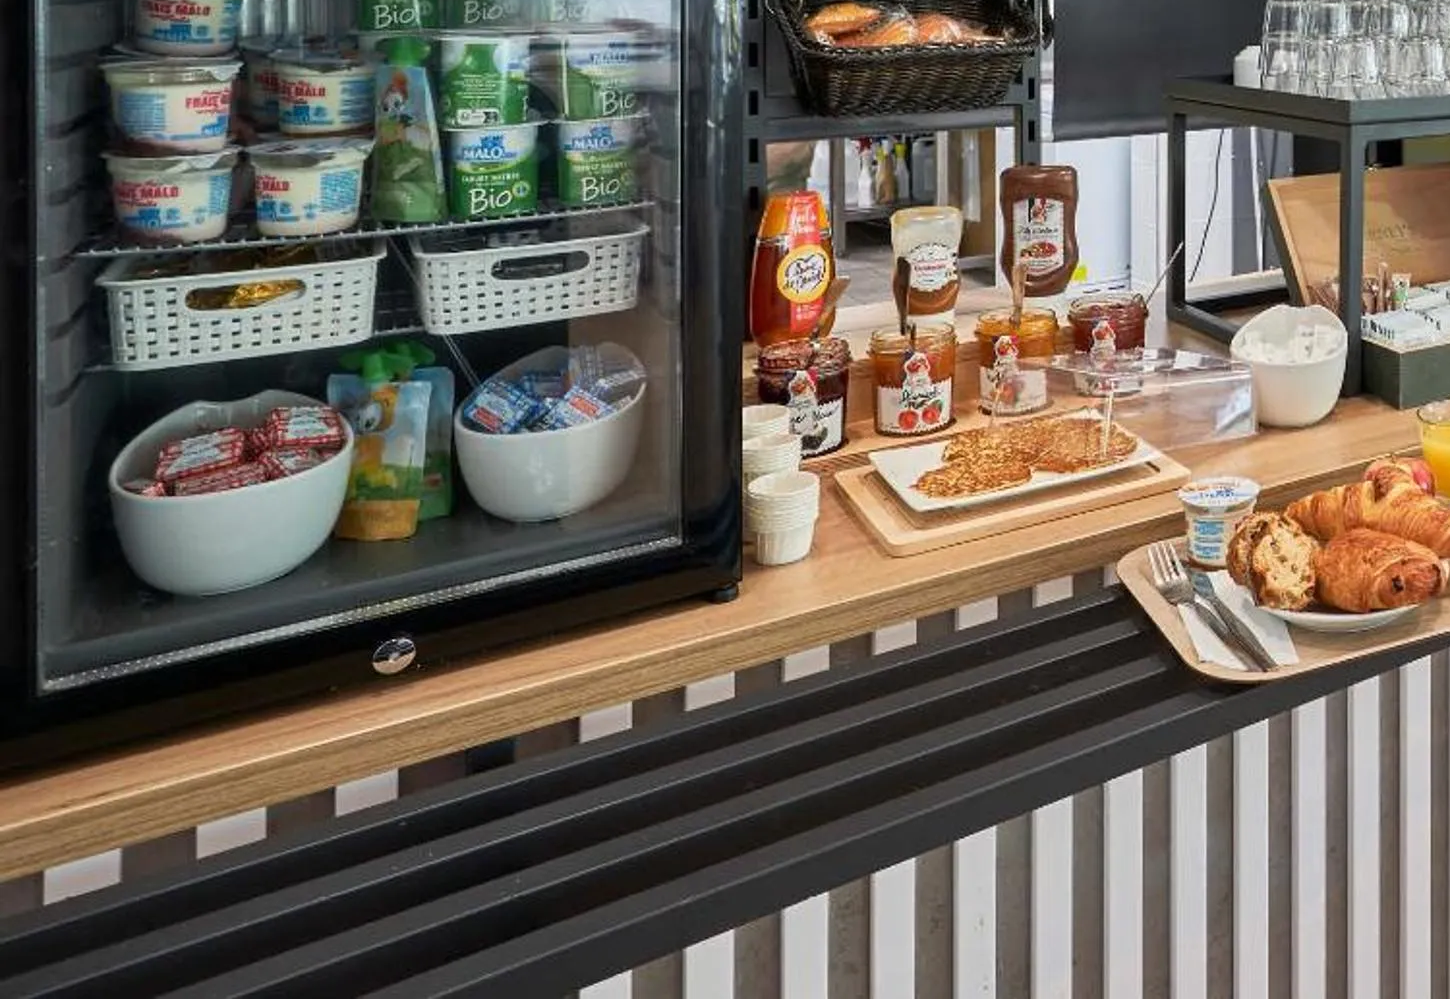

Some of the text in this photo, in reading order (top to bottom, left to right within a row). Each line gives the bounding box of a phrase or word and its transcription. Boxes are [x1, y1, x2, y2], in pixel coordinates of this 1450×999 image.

[374, 4, 416, 29] Bio
[465, 0, 503, 24] Bio
[469, 188, 513, 214] Bio
[581, 177, 620, 201] Bio
